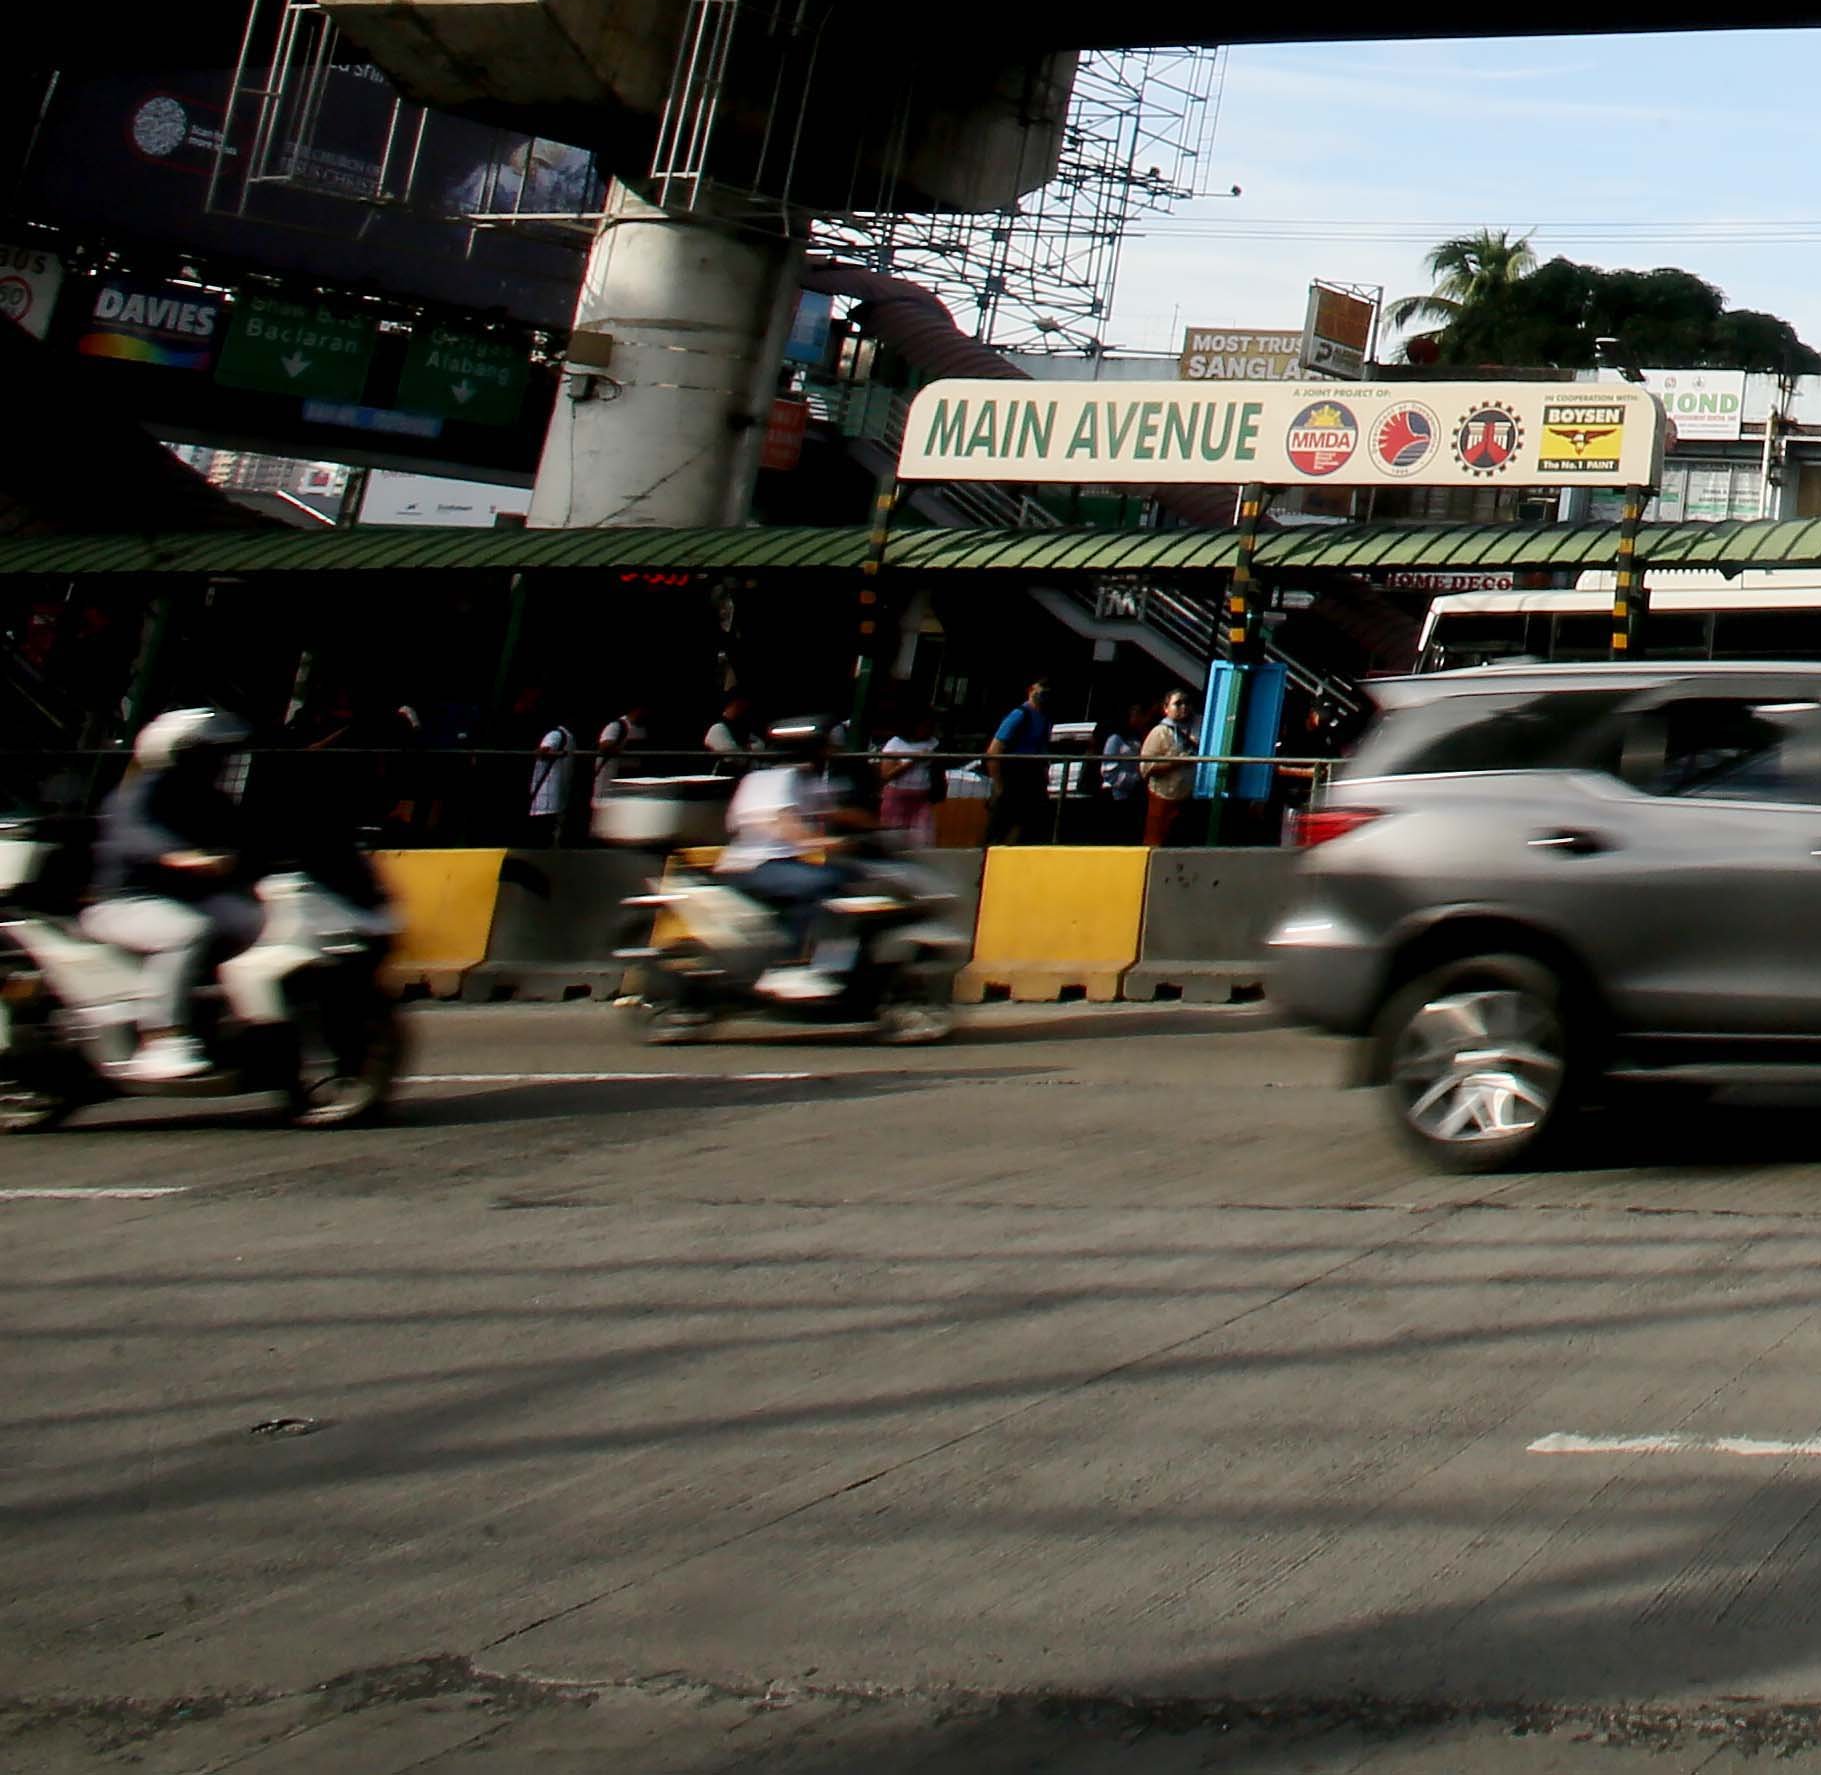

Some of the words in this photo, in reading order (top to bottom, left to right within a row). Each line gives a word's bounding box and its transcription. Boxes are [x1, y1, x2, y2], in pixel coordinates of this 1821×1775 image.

[94, 287, 217, 336] DAVIES
[245, 317, 358, 352] Baclaran
[1193, 334, 1252, 353] MOST
[1302, 389, 1331, 397] JOINT
[1333, 389, 1373, 397] PROJECT
[1548, 408, 1620, 423] BOYSEN
[923, 399, 1058, 458] MAIN
[1065, 400, 1264, 461] AVENUE
[1292, 431, 1350, 449] MMDA
[1543, 460, 1559, 470] The
[1586, 461, 1615, 470] PAINT
[1451, 575, 1514, 591] DECO
